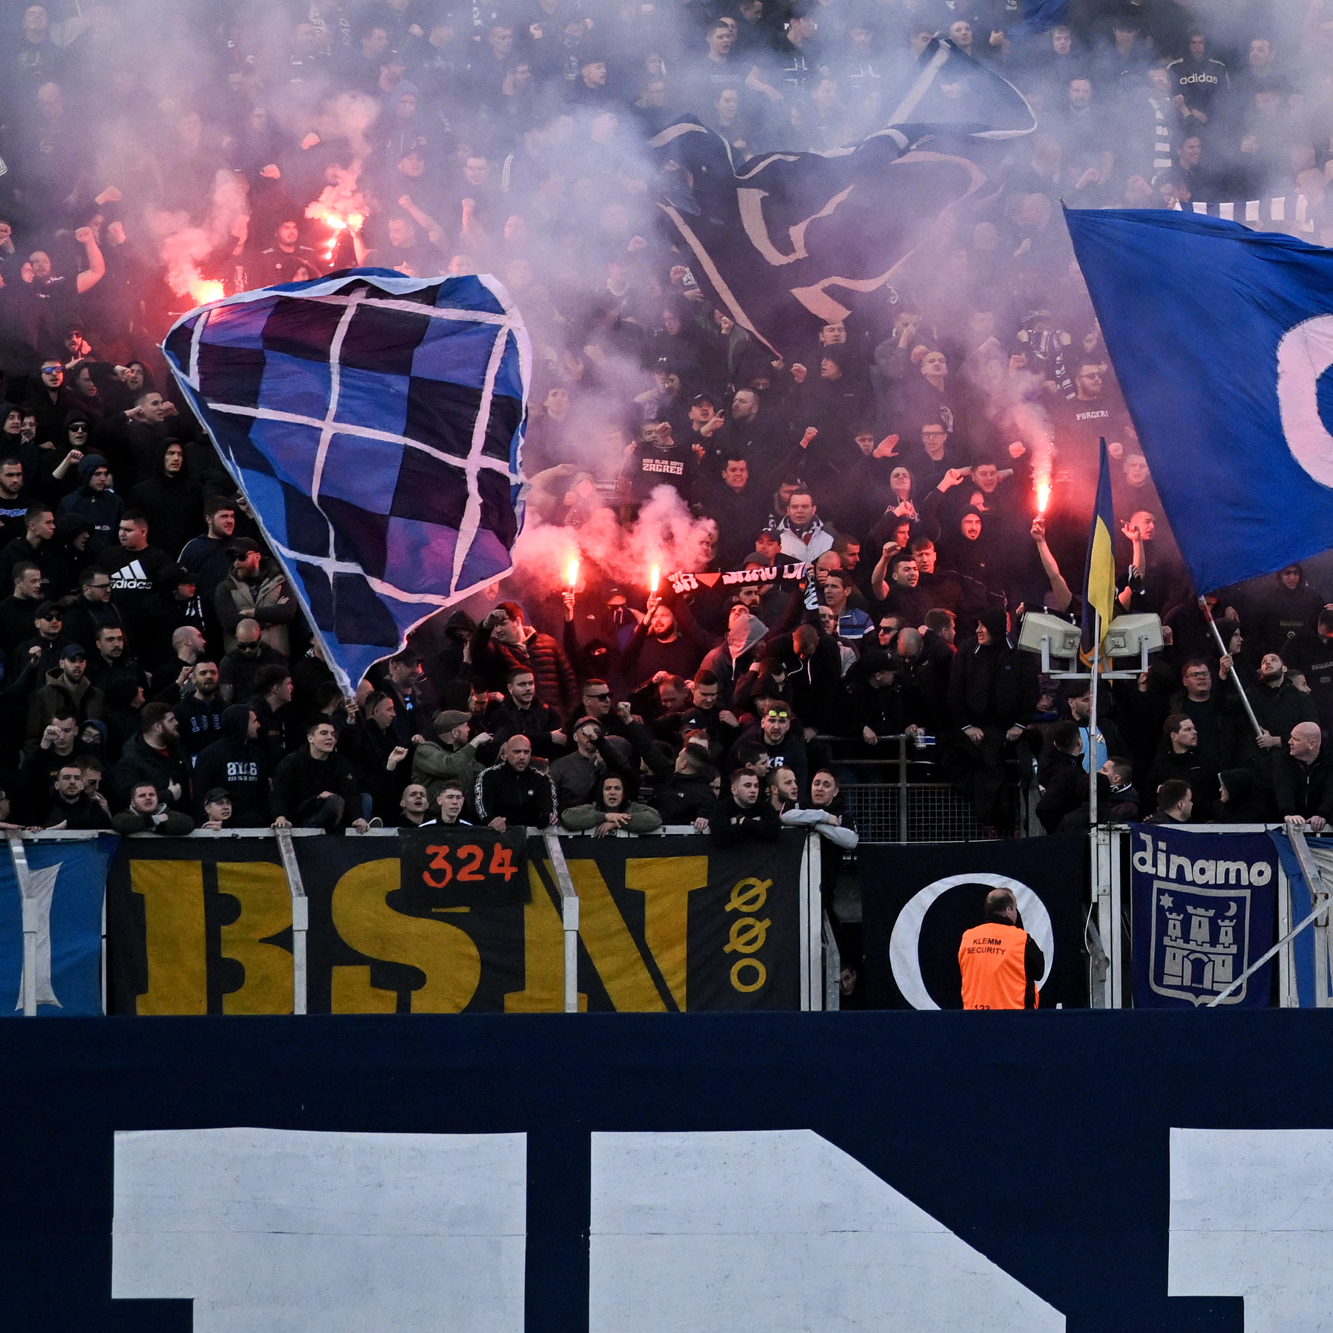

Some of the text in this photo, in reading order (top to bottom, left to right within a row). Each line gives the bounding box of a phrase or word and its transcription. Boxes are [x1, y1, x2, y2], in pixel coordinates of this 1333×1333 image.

[1179, 72, 1218, 85] adidas
[642, 463, 684, 475] ZAGREB
[421, 840, 519, 889] 324
[1132, 831, 1272, 887] dinamo
[972, 937, 1002, 946] KLEMM
[966, 945, 1007, 956] SECURITY
